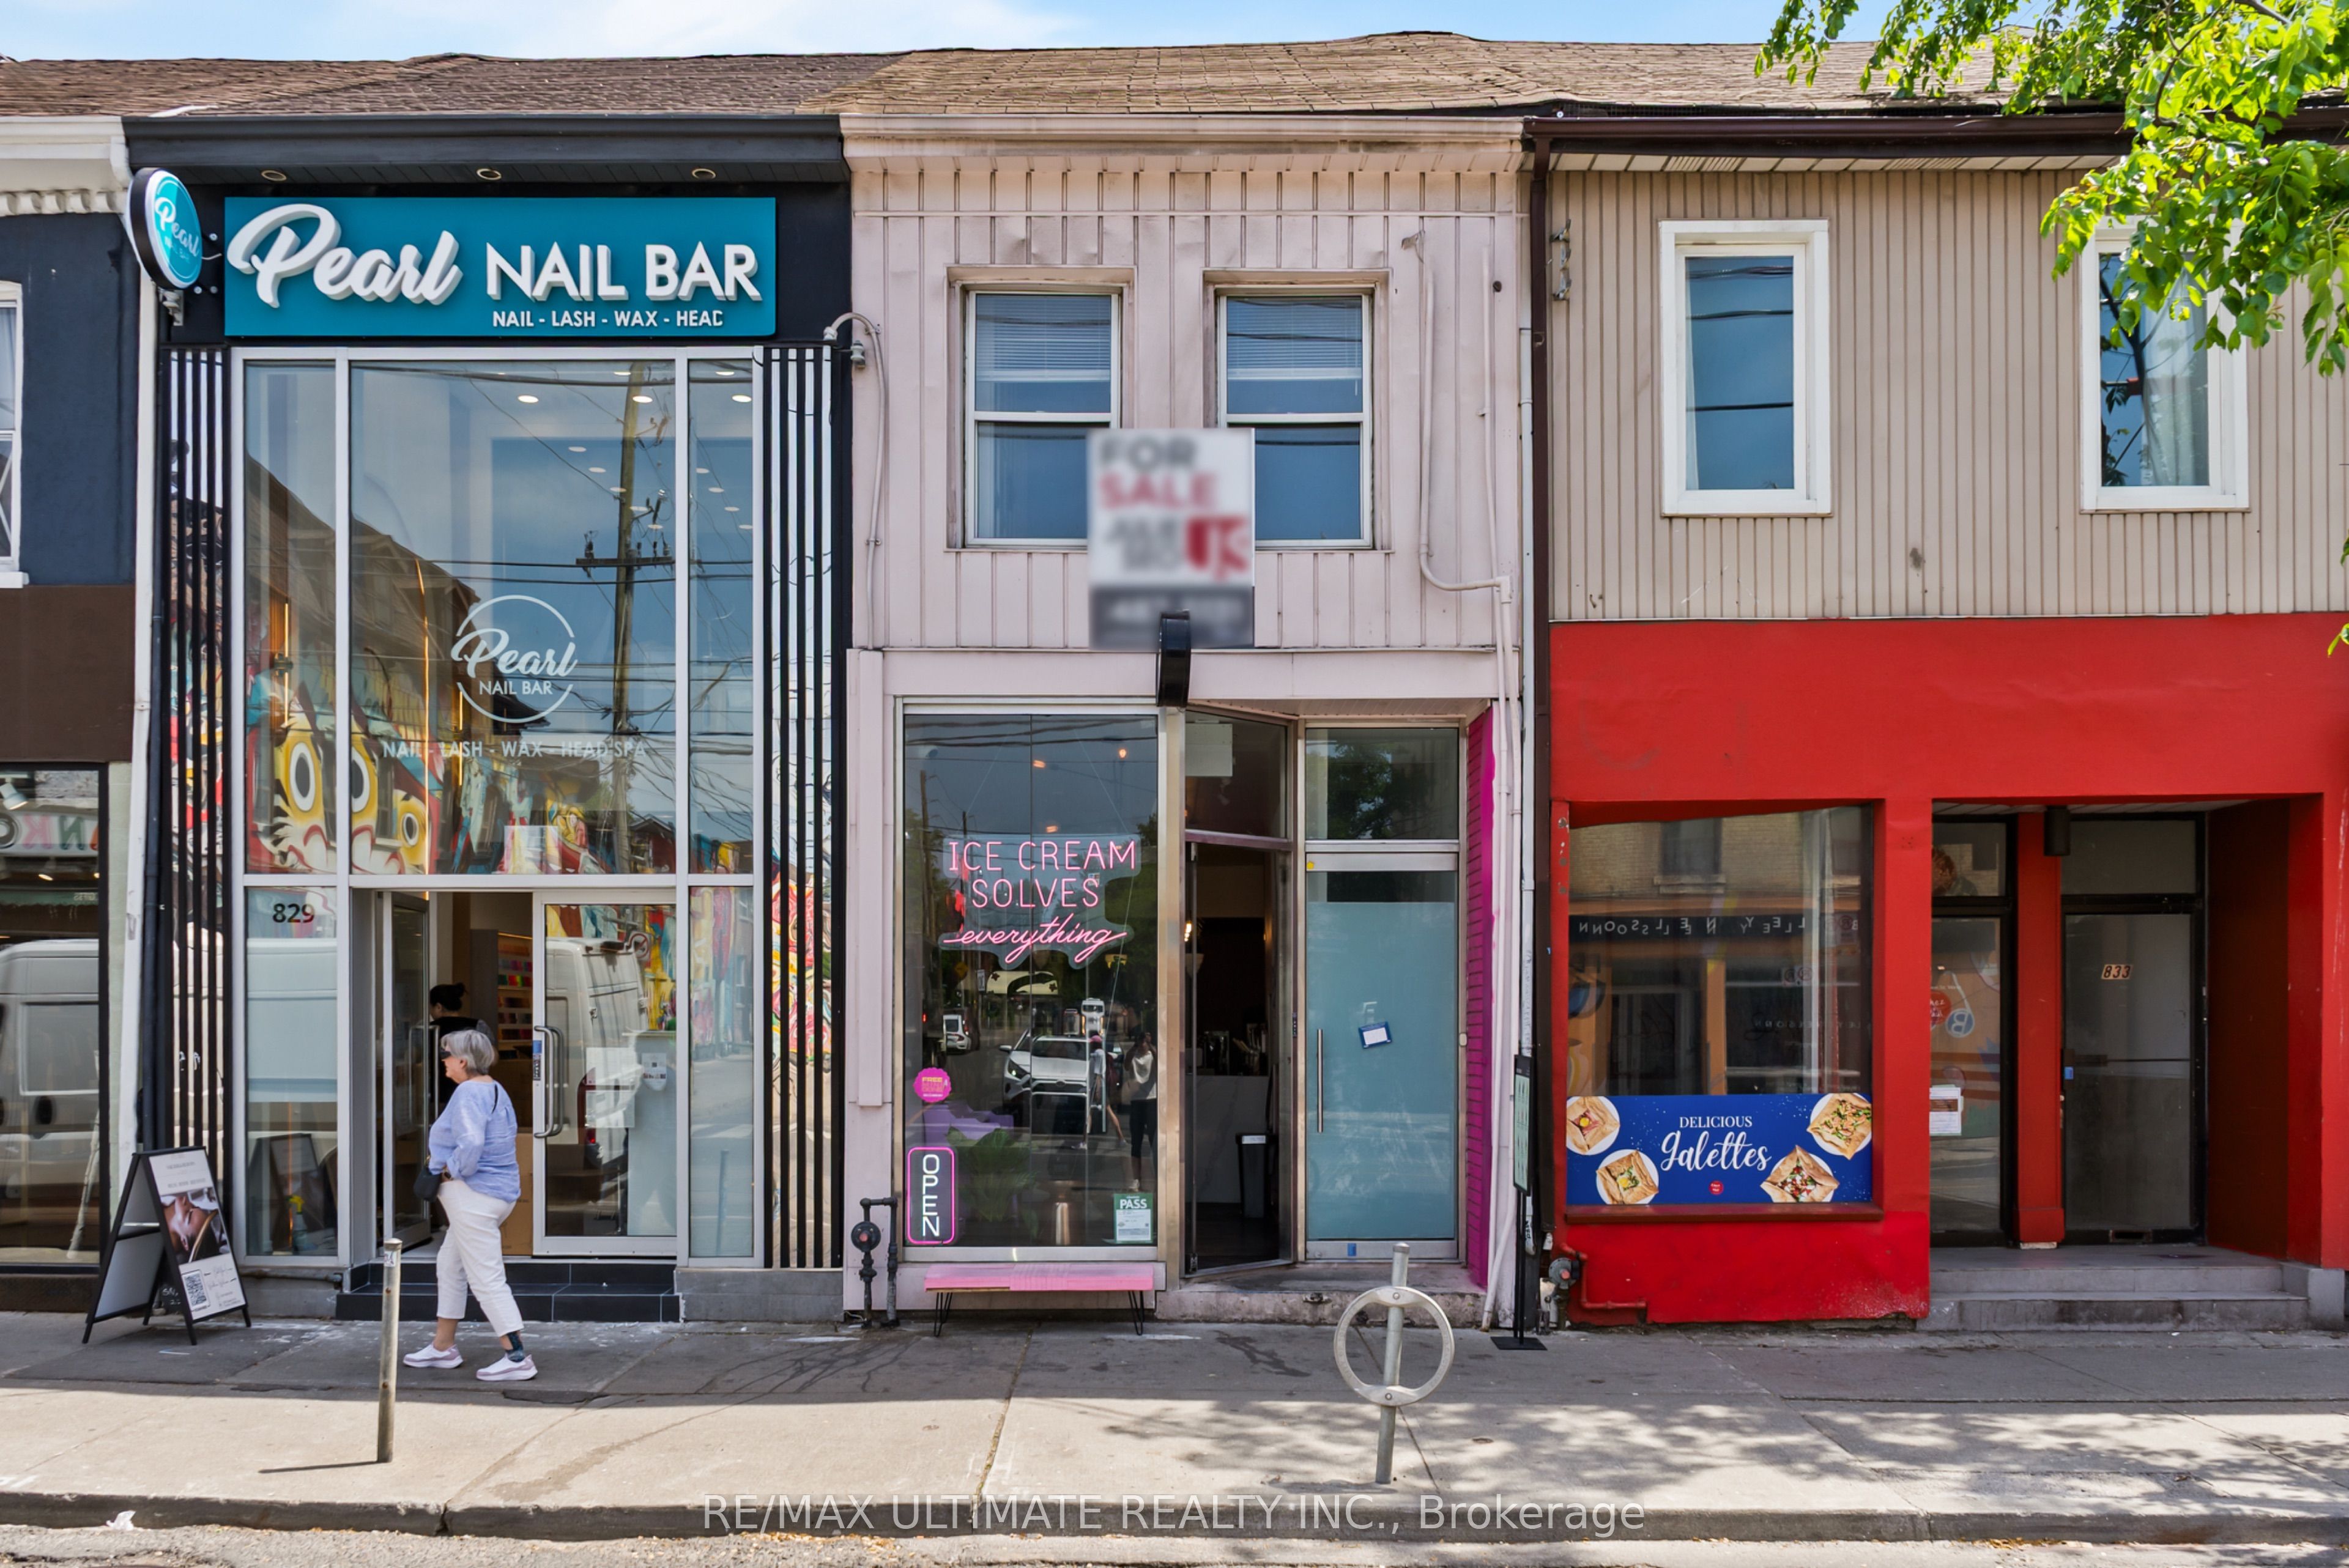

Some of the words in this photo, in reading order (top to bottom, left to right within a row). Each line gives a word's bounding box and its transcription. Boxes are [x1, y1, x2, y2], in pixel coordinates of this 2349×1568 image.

[155, 196, 199, 257] Pearl
[227, 203, 464, 309] Pearl
[486, 241, 629, 302] NAIL
[645, 241, 763, 301] BAR
[492, 310, 534, 327] NAIL
[552, 310, 596, 327] LASH
[614, 310, 658, 327] WAX
[451, 628, 577, 678] Pearl
[480, 681, 517, 695] NAIL
[522, 681, 553, 695] BAR
[384, 742, 422, 758] NAIL
[441, 742, 483, 758] LASH
[501, 741, 543, 758] WAX
[562, 741, 607, 758] HEAD
[614, 741, 646, 757] SPA
[949, 841, 1002, 871] ICE
[1019, 841, 1135, 871] CREAM
[972, 879, 1099, 908] SOLVES
[272, 903, 315, 923] 829
[943, 913, 1127, 964] everything
[2104, 965, 2131, 978] 833
[1679, 1115, 1753, 1128] DELICIOUS
[922, 1153, 941, 1237] OPEN
[1119, 1199, 1148, 1209] PASS
